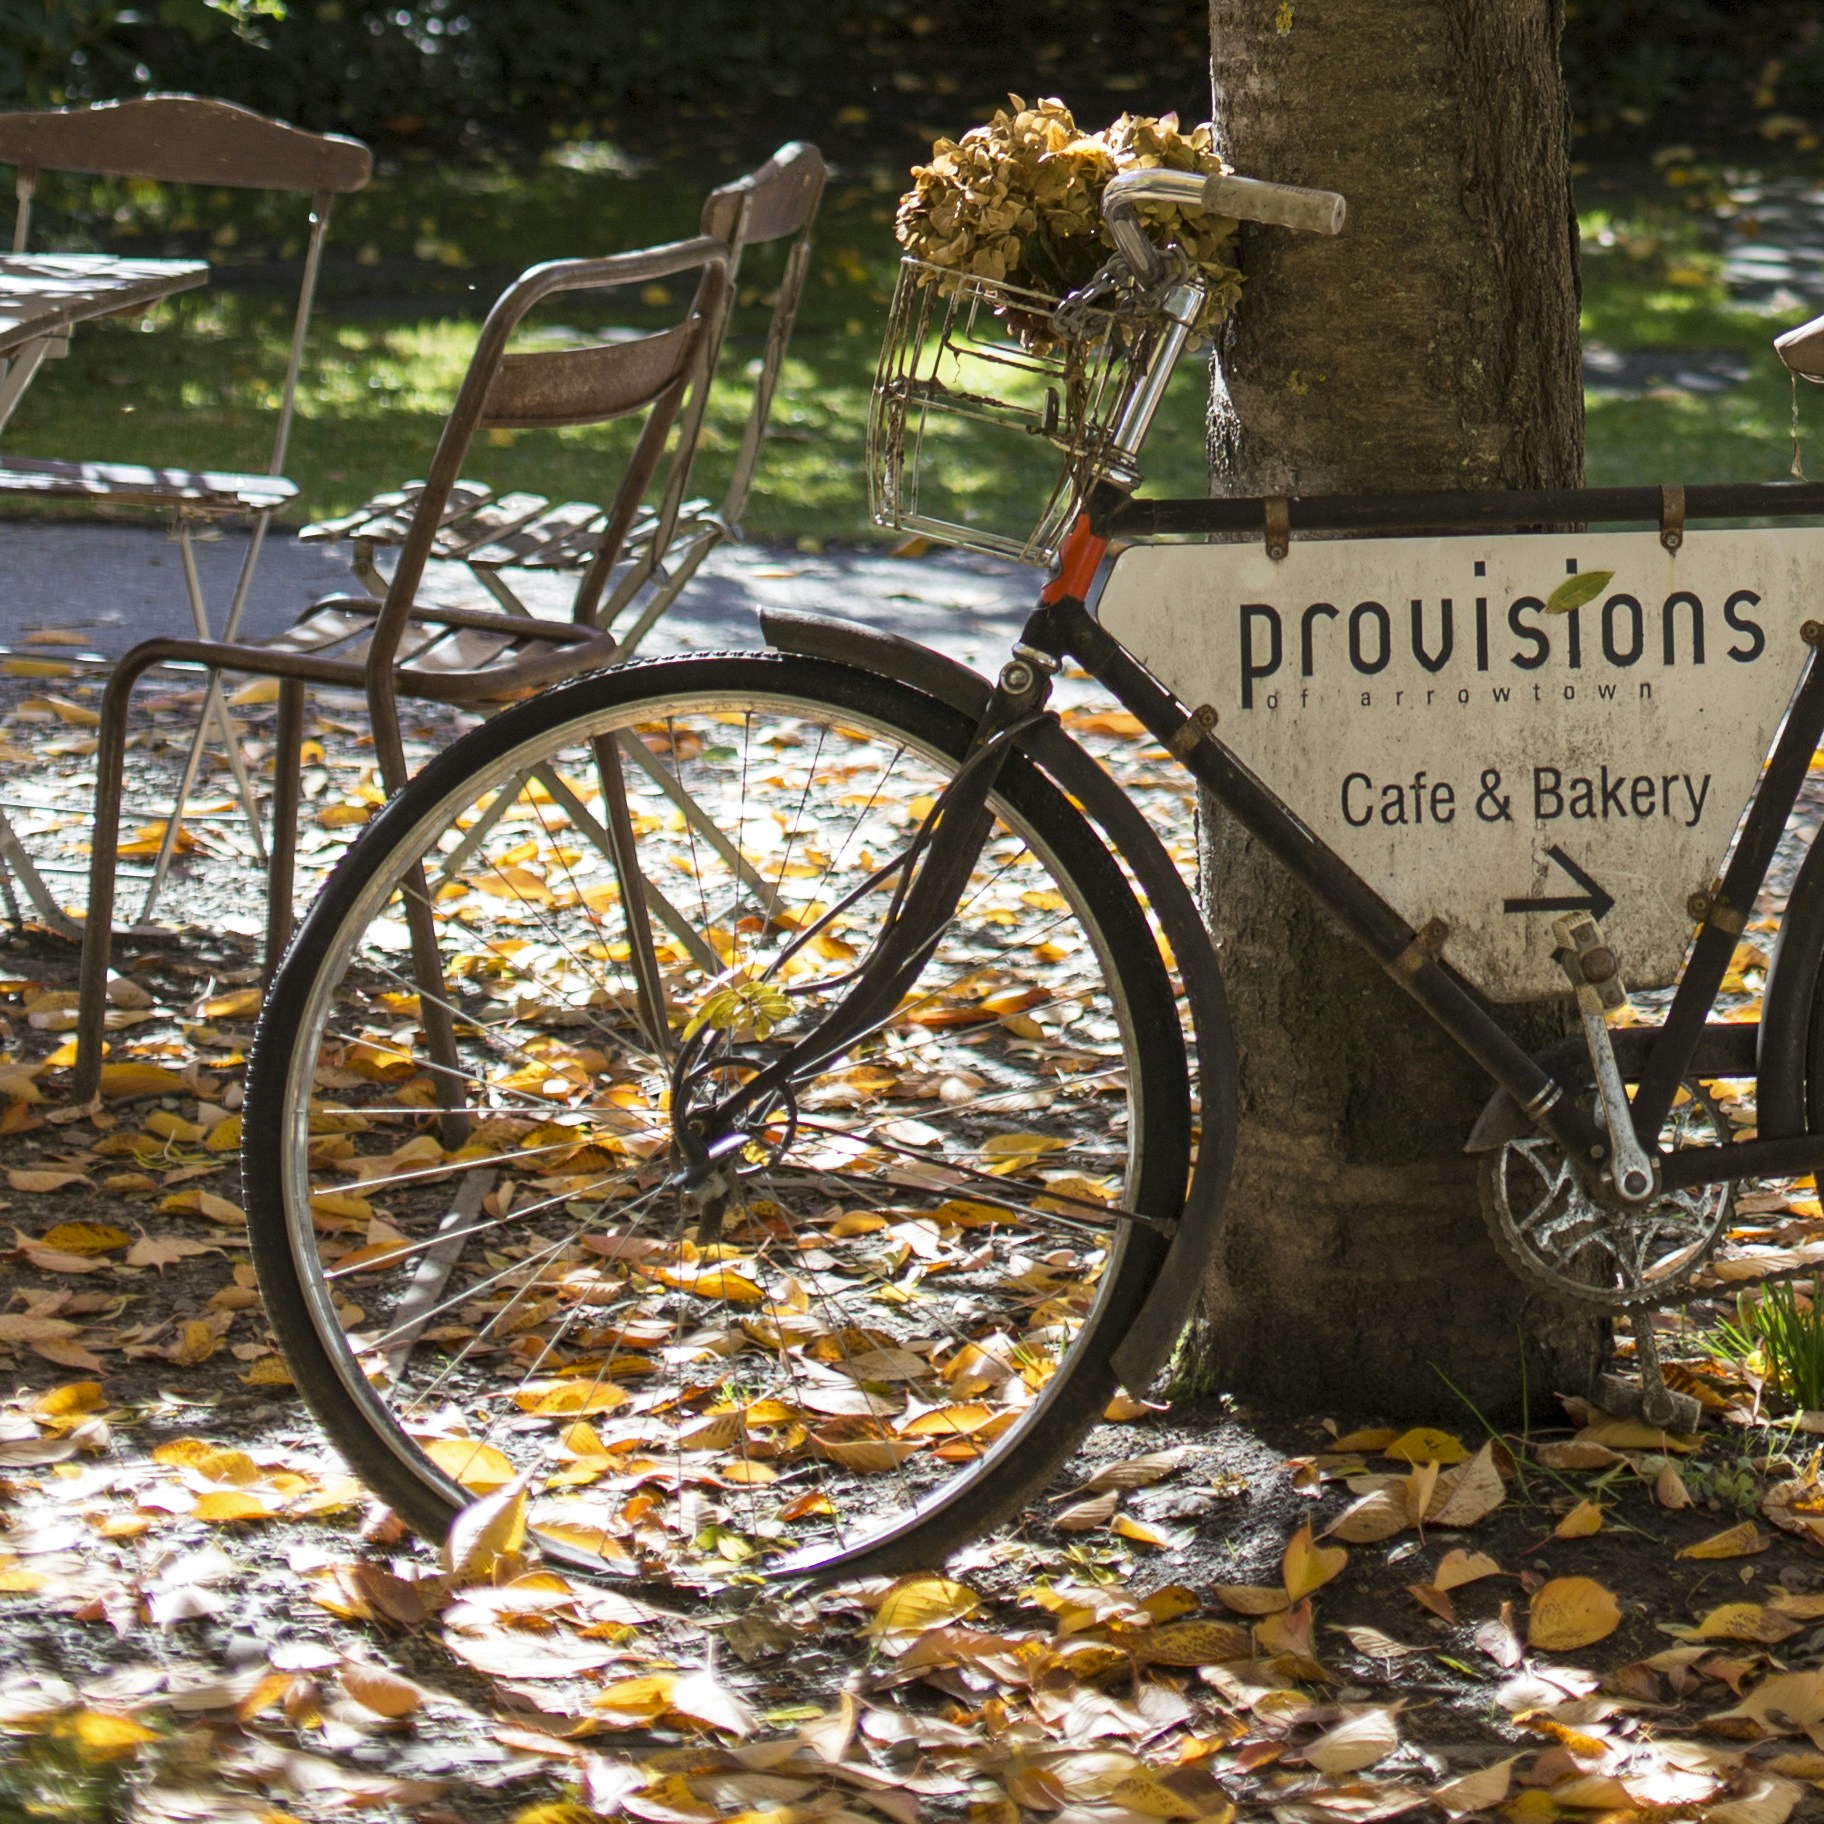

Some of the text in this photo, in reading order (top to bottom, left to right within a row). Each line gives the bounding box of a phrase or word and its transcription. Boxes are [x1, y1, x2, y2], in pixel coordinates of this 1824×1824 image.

[1240, 558, 1766, 709] provisions
[1266, 680, 1652, 710] of arrowtown
[1341, 765, 1711, 828] Cafe & Bakery
